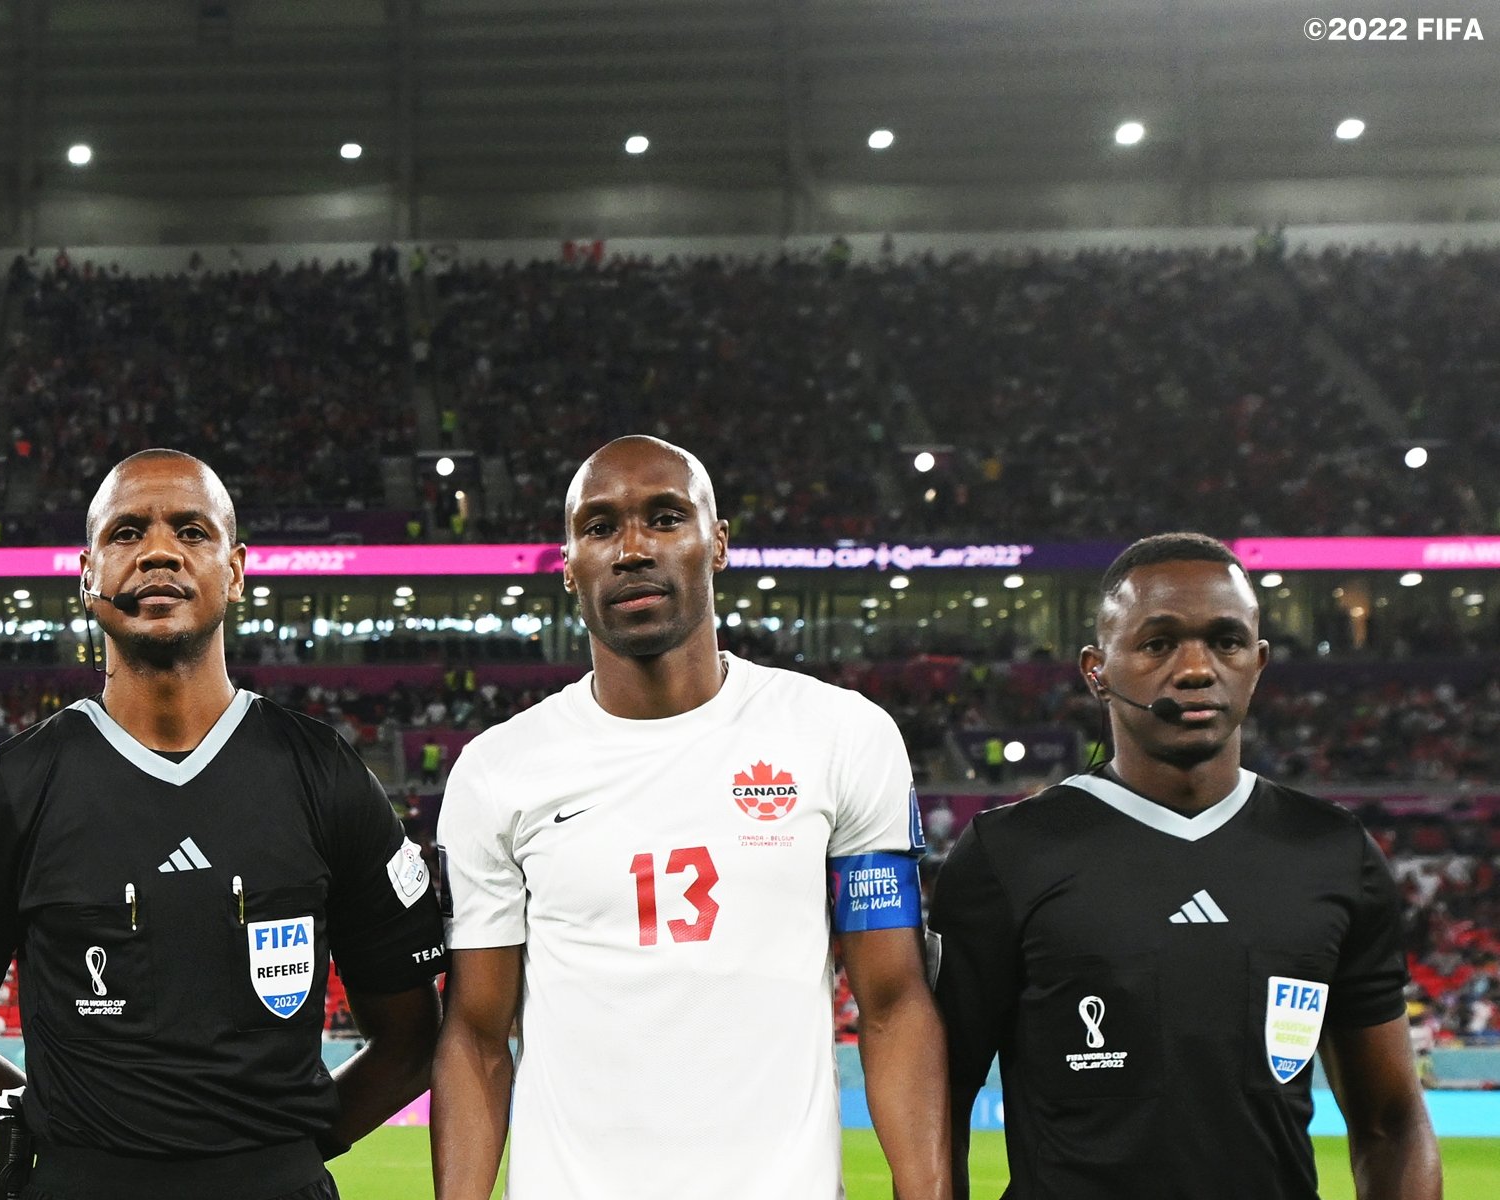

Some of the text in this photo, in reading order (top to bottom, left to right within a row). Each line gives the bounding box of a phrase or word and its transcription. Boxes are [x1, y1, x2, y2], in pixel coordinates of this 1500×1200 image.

[834, 548, 875, 567] CUP
[732, 786, 797, 797] CANADA
[849, 867, 896, 882] FOOTBALL
[629, 846, 720, 946] 13
[849, 879, 899, 898] UNITES
[850, 895, 902, 912] the World
[255, 923, 309, 951] FIFA
[257, 961, 309, 979] REFEREE
[90, 999, 113, 1007] WORLD
[113, 999, 126, 1007] CUP
[274, 995, 298, 1009] 2022
[1275, 984, 1320, 1012] FIFA
[1276, 1060, 1297, 1073] 2022
